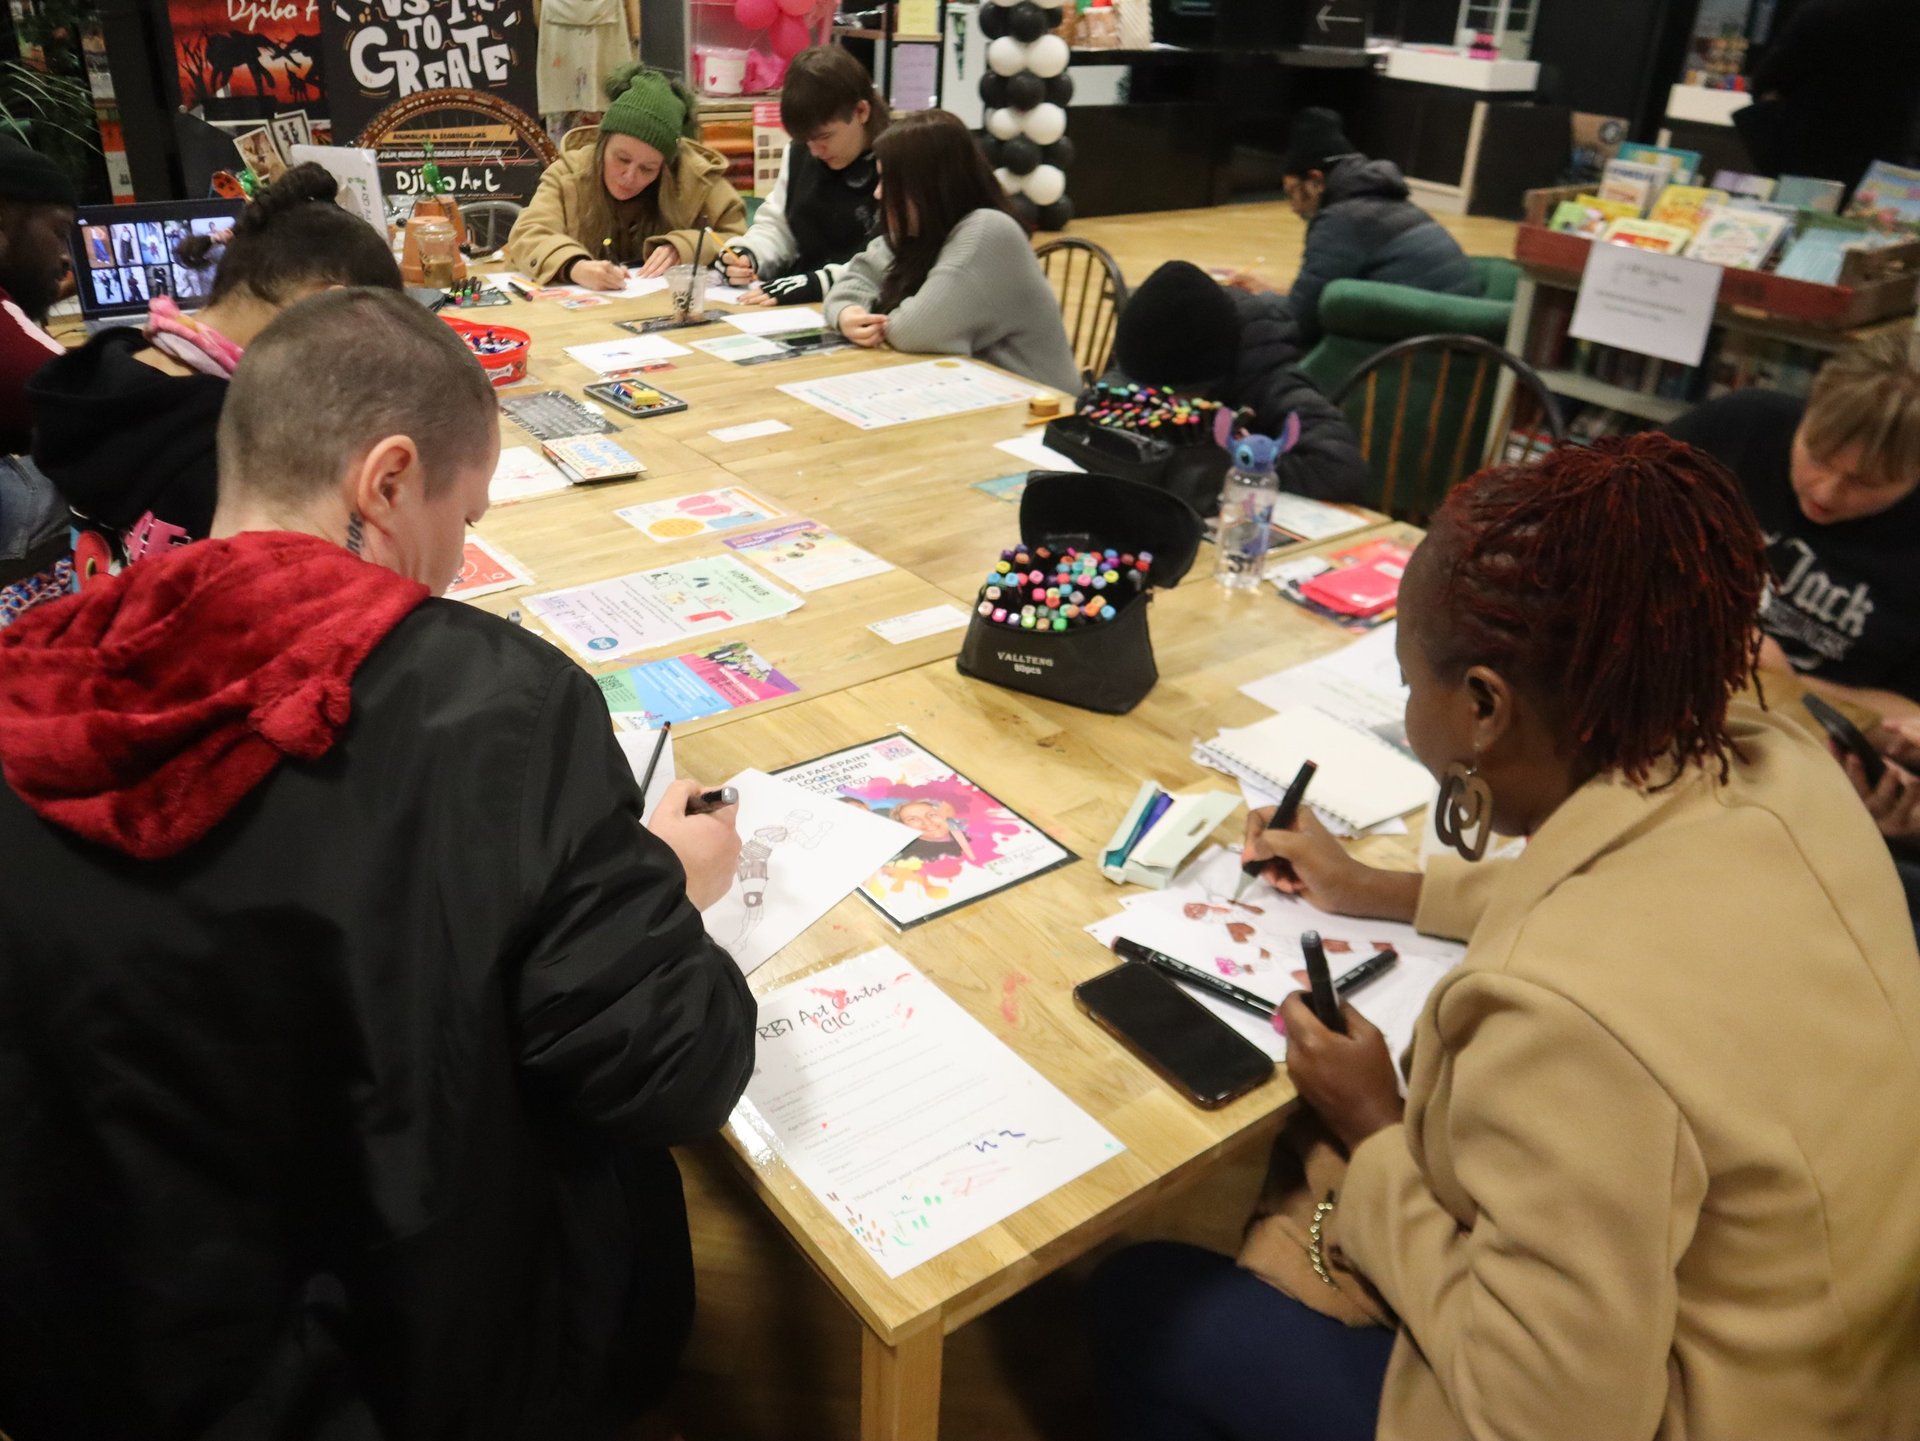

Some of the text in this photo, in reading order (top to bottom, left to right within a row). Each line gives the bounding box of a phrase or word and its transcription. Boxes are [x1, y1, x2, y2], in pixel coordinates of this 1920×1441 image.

[228, 0, 298, 31] Djibo
[396, 15, 443, 50] TO
[350, 24, 511, 98] CREATE
[396, 166, 501, 194] Djio Art
[1762, 531, 1875, 637] Jack
[796, 770, 839, 787] LOONS
[842, 761, 868, 774] AND
[806, 752, 871, 776] FACEPAINT
[798, 1004, 830, 1026] Art
[831, 983, 886, 1011] Centre
[820, 1011, 856, 1034] CIC
